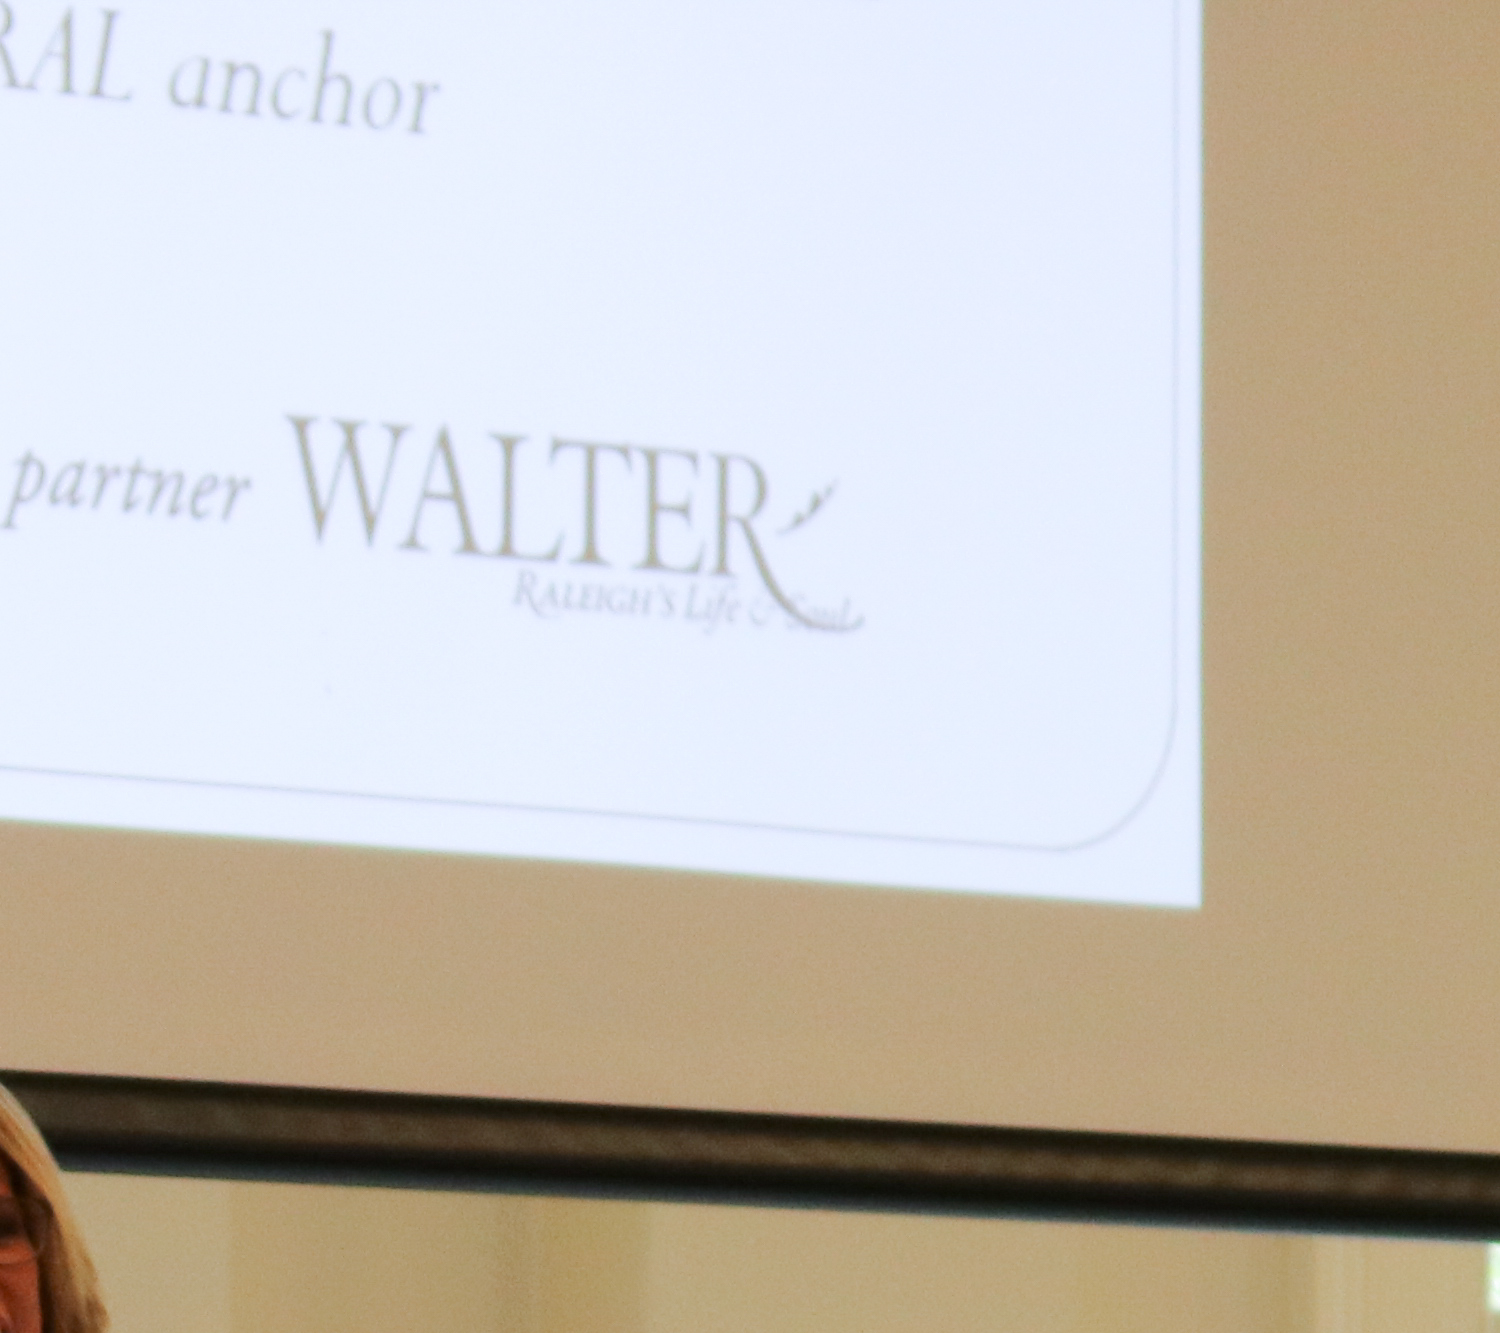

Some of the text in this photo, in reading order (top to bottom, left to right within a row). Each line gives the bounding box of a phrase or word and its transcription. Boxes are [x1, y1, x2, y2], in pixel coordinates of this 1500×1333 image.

[167, 28, 442, 135] anchor
[0, 448, 253, 532] partner
[286, 414, 864, 634] WALTER
